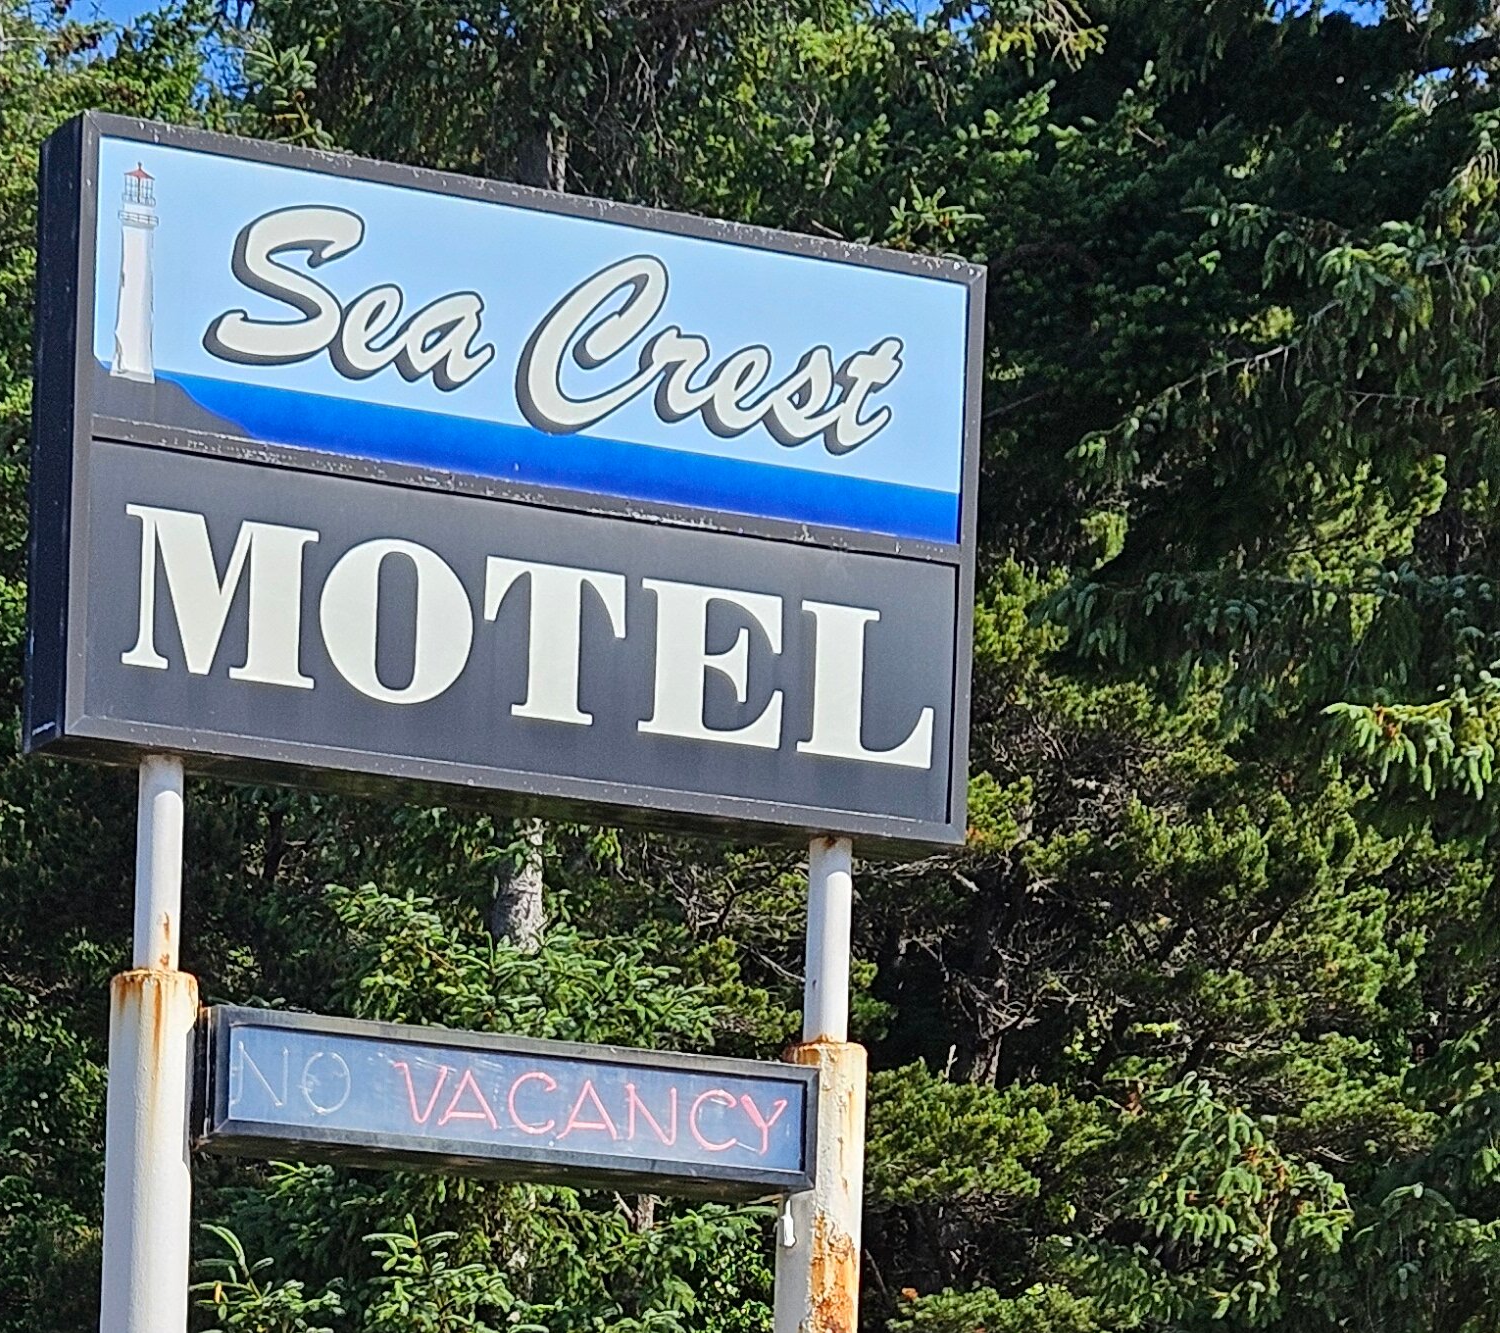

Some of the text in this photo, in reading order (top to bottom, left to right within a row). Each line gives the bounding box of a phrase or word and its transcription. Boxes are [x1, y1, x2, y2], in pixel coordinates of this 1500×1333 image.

[204, 205, 904, 454] Sea Crest
[120, 503, 934, 769] MOTEL
[231, 1040, 787, 1154] NO VACANCY
